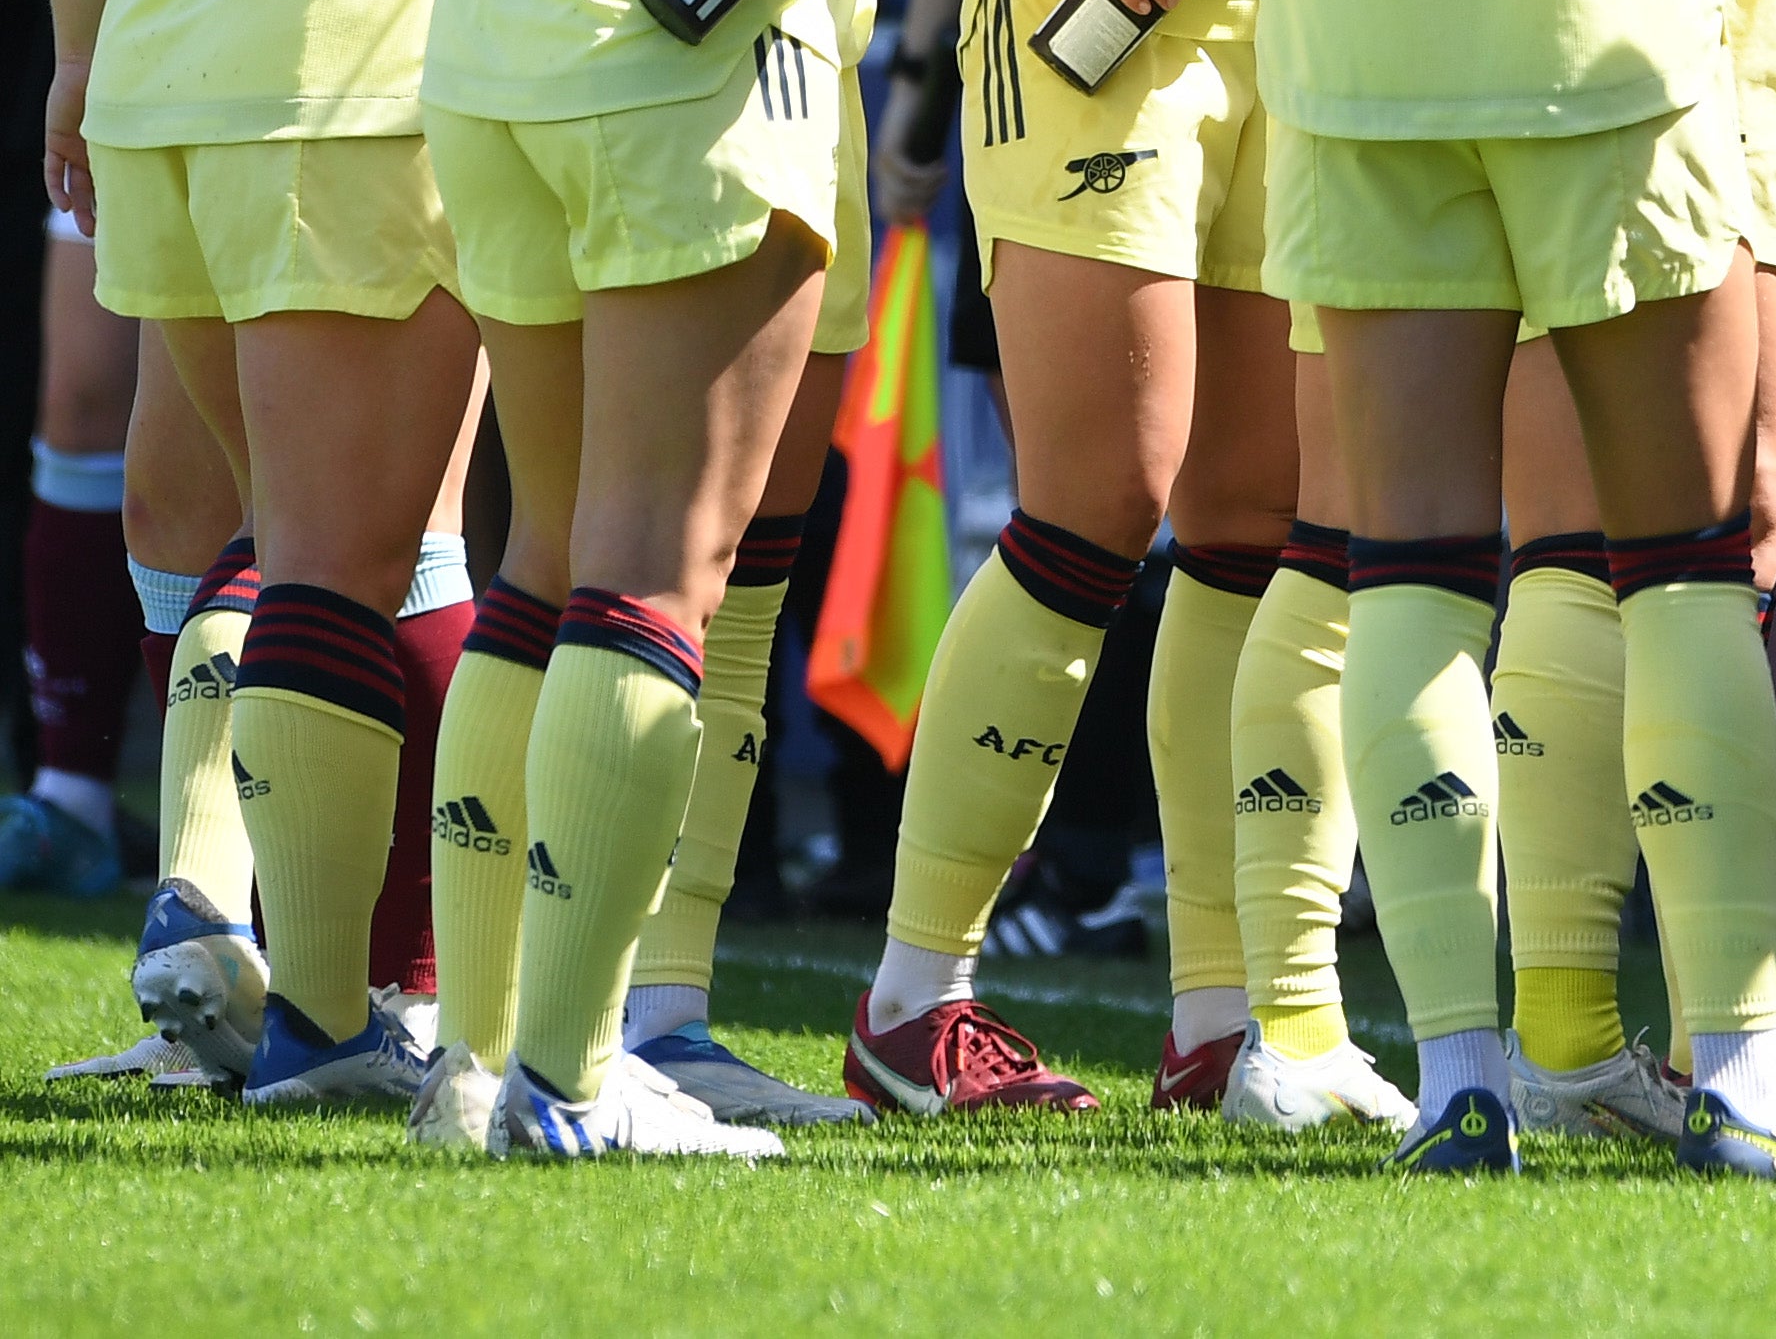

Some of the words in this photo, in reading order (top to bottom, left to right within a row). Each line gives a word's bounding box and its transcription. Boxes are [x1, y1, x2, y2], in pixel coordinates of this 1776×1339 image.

[167, 681, 236, 708] adid
[972, 725, 1066, 766] AFC
[1235, 795, 1322, 815] adidas
[1391, 797, 1489, 826] adidas
